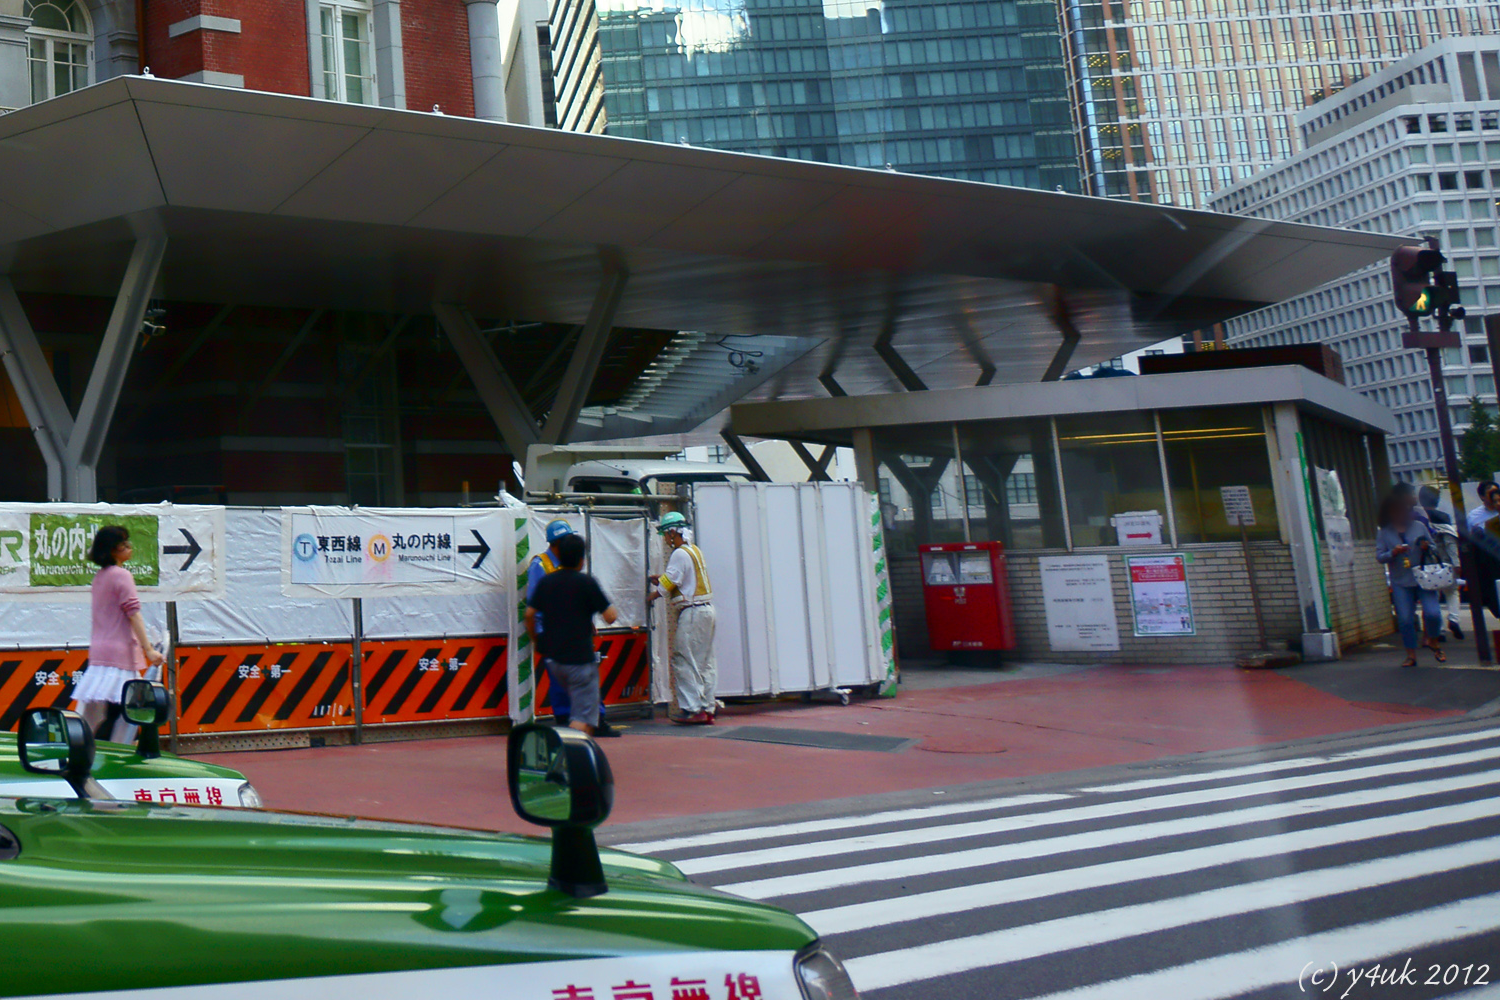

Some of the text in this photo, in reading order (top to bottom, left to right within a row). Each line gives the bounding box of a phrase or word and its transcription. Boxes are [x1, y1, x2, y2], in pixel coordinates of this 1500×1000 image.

[317, 535, 362, 552] 東西線
[392, 533, 452, 550] 丸の内線
[373, 543, 385, 555] M
[325, 555, 362, 563] Tozai Line
[399, 554, 435, 562] Marunouchi
